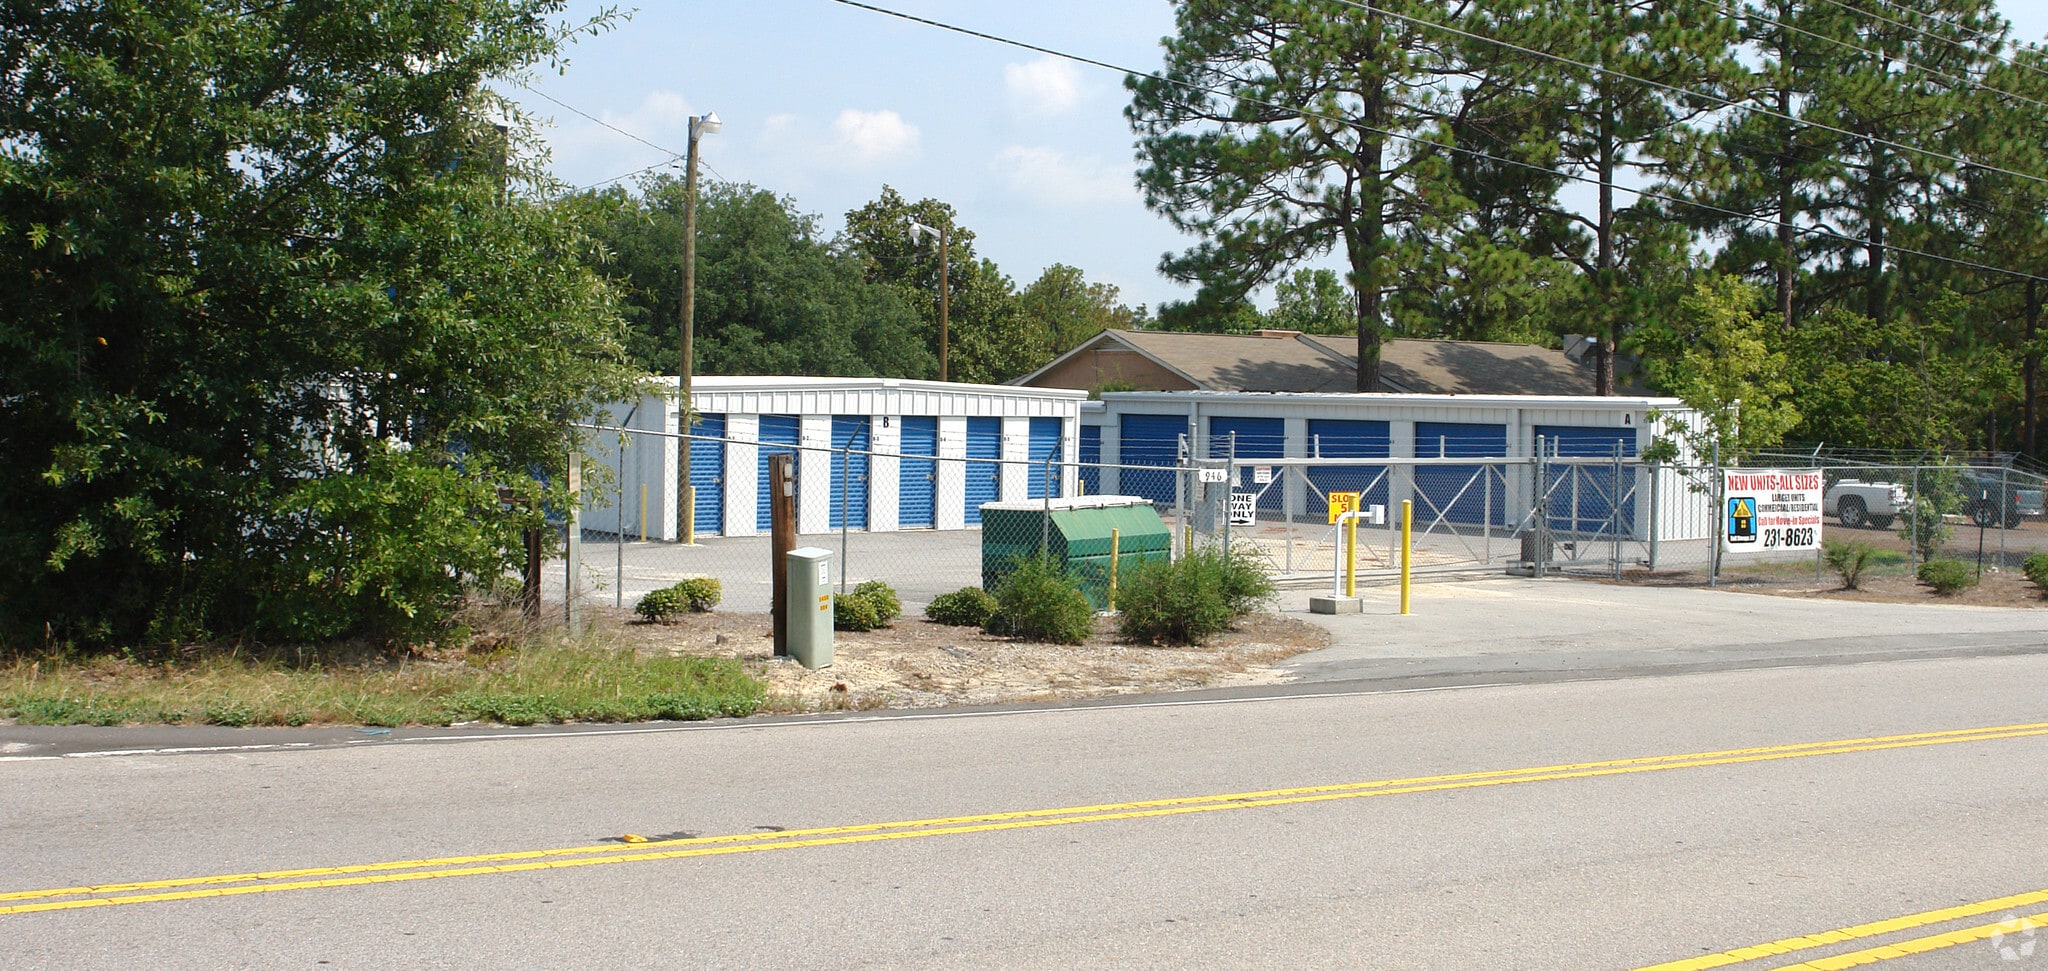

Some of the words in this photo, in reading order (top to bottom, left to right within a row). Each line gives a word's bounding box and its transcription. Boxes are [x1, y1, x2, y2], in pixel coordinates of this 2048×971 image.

[883, 416, 889, 428] B
[1624, 413, 1631, 425] A
[1205, 471, 1222, 481] 946
[1728, 475, 1748, 490] NEW
[1795, 474, 1819, 490] SIZES
[1331, 494, 1349, 503] SLO
[1341, 503, 1347, 513] 5
[1758, 517, 1767, 526] Call
[1799, 515, 1820, 525] Specials
[1764, 527, 1813, 547] 231-8623
